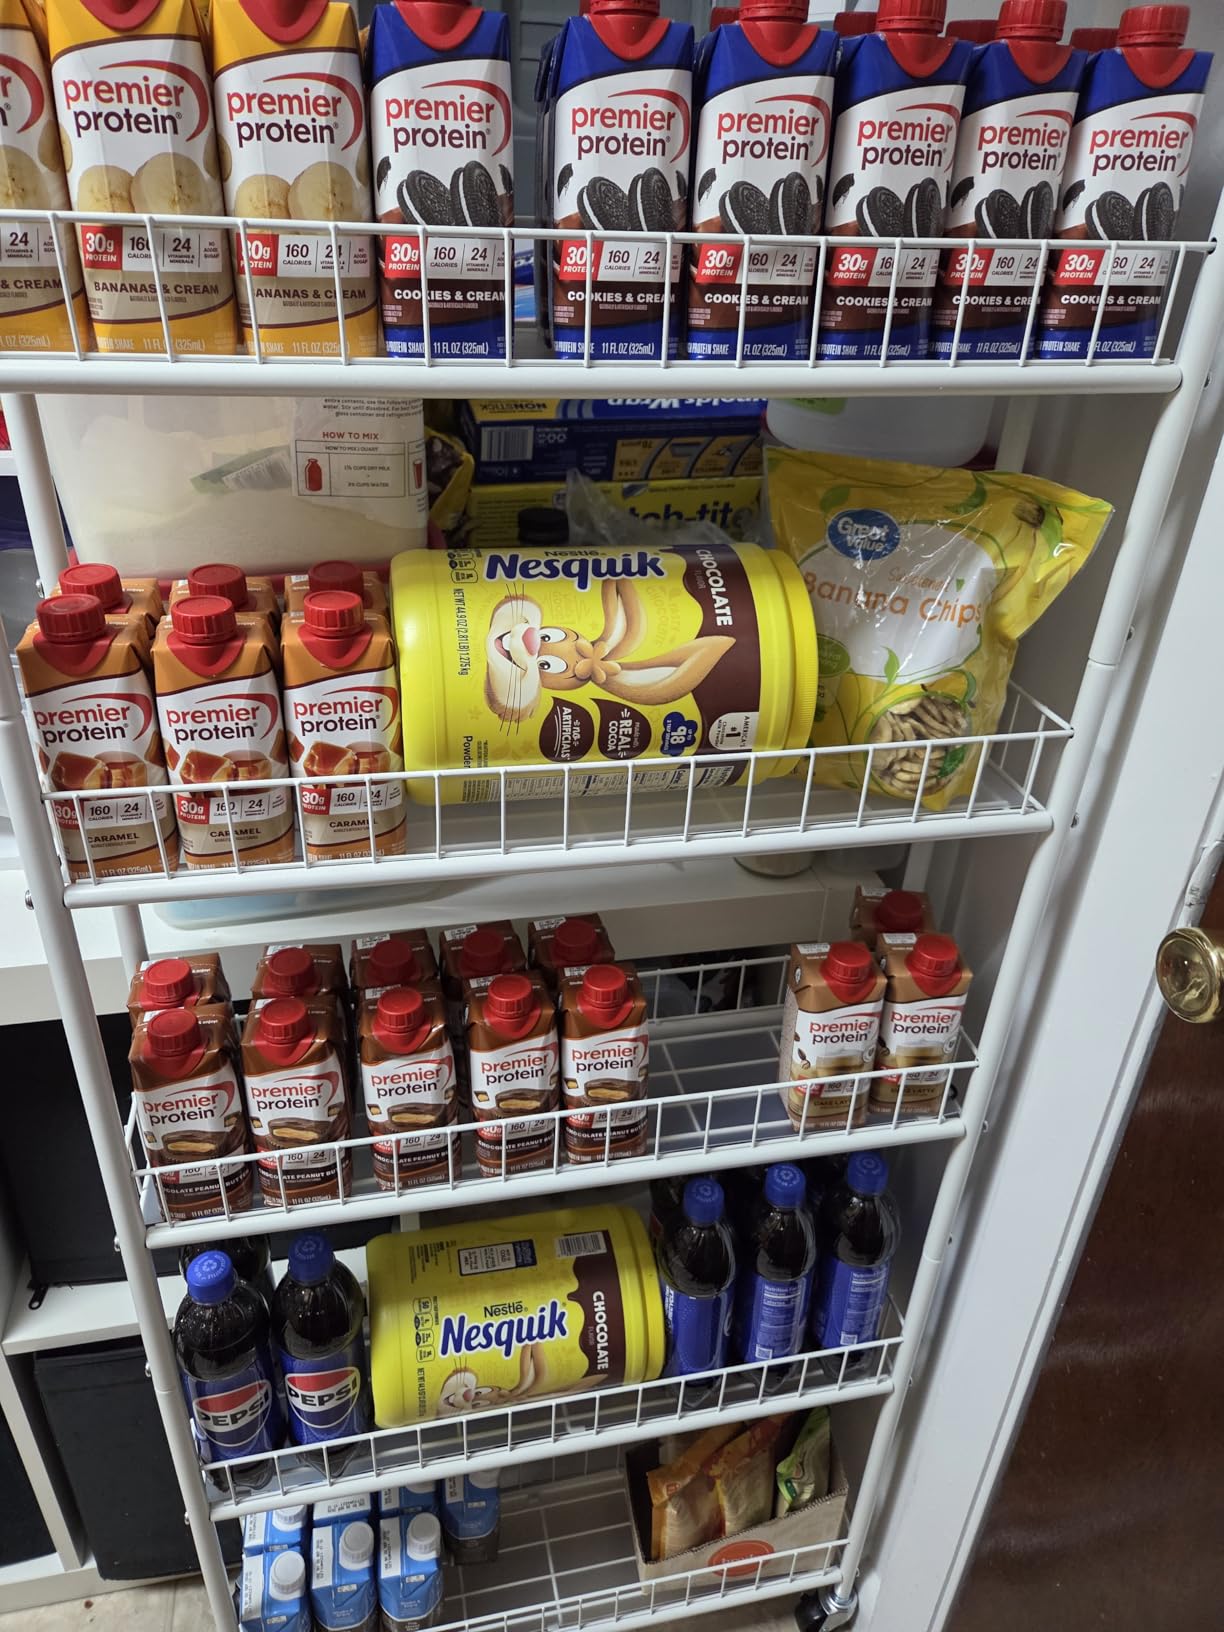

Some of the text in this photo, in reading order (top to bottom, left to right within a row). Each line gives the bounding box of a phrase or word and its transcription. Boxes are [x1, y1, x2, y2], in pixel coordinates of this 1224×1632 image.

[63, 76, 184, 110] premier
[227, 88, 342, 121] premier
[385, 94, 495, 126] premier
[74, 108, 178, 138] protein
[571, 103, 675, 136] premier
[717, 109, 819, 139] premier
[236, 117, 335, 148] protein
[394, 124, 487, 153] protein
[858, 117, 952, 146] premier
[978, 123, 1066, 150] premier
[1090, 124, 1189, 154] premier
[577, 132, 666, 160] protein
[722, 136, 809, 164] protein
[862, 145, 943, 170] protein
[982, 148, 1058, 173] protein
[1092, 150, 1176, 176] protein
[9, 232, 29, 246] 24
[86, 232, 114, 254] 30g
[172, 238, 191, 252] 24
[86, 254, 116, 262] PROTEIN
[285, 244, 308, 258] 160
[390, 244, 419, 262] 30g
[434, 246, 456, 261] 160
[471, 248, 487, 261] 24
[608, 250, 630, 263] 160
[644, 251, 660, 264] 24
[705, 250, 734, 268] 30g
[388, 263, 420, 271] PROTEIN
[781, 254, 798, 267] 24
[838, 254, 868, 271] 30g
[911, 257, 926, 269] 24
[996, 257, 1014, 269] 160
[1024, 257, 1038, 269] 24
[1065, 254, 1095, 271] 30g
[1139, 257, 1155, 269] 24
[14, 280, 62, 289] CREAM
[94, 282, 219, 294] BANANAS & CREAM
[256, 289, 320, 298] ANANAS &
[454, 290, 463, 300] &
[625, 293, 633, 302] &
[704, 293, 808, 305] COOKES & CREAM
[836, 296, 932, 306] COOKIES CREAM
[1004, 297, 1011, 305] &
[1117, 296, 1160, 304] & CREAM
[434, 342, 488, 355] 11 FL OZ (325mL)
[602, 343, 654, 355] 11 FL OZ (325mL)
[713, 344, 729, 354] SHAKE
[744, 344, 787, 356] FL OZ (325mL)
[998, 343, 1020, 353] (325mL)
[1064, 341, 1080, 351] SHAKE
[1111, 341, 1136, 352] (325mL)
[837, 516, 890, 541] Great
[846, 535, 885, 551] Value
[486, 552, 664, 590] Nesquik
[454, 588, 465, 596] NET
[696, 549, 733, 626] CHOCOLATE
[455, 597, 466, 606] WT
[803, 573, 981, 628] Banana Chips
[34, 703, 130, 729] premier
[166, 701, 260, 728] premier
[294, 697, 383, 722] premier
[174, 721, 255, 745] protein
[300, 714, 378, 737] protein
[572, 726, 580, 740] no
[42, 722, 126, 747] protein
[607, 720, 618, 751] COCOA
[618, 719, 632, 750] REAL
[670, 726, 687, 744] 98
[463, 736, 473, 768] Powder
[248, 799, 262, 809] 24
[302, 792, 324, 805] 30g
[336, 793, 355, 802] 160
[90, 805, 111, 816] 160
[124, 803, 139, 813] 24
[181, 800, 204, 814] 30g
[180, 812, 205, 820] PROTEIN
[88, 832, 140, 843] CARAMEL
[891, 1011, 956, 1025] premier
[809, 1020, 874, 1034] premier
[893, 1023, 950, 1034] protein
[813, 1032, 868, 1044] protein
[572, 1045, 639, 1062] premier
[481, 1054, 549, 1073] premier
[576, 1057, 635, 1073] protein
[371, 1067, 441, 1086] premier
[486, 1067, 545, 1085] protein
[251, 1083, 324, 1100] premier
[376, 1082, 437, 1098] protein
[143, 1093, 219, 1113] premier
[257, 1096, 319, 1112] protein
[150, 1108, 215, 1126] protein
[511, 1122, 525, 1130] 160
[517, 1139, 543, 1147] PEANUT
[313, 1151, 324, 1159] 24
[441, 1301, 567, 1356] Nesquik
[592, 1291, 609, 1370] CHOCOLATE
[289, 1376, 358, 1406] PEPSI
[200, 1390, 269, 1426] PEPSI
